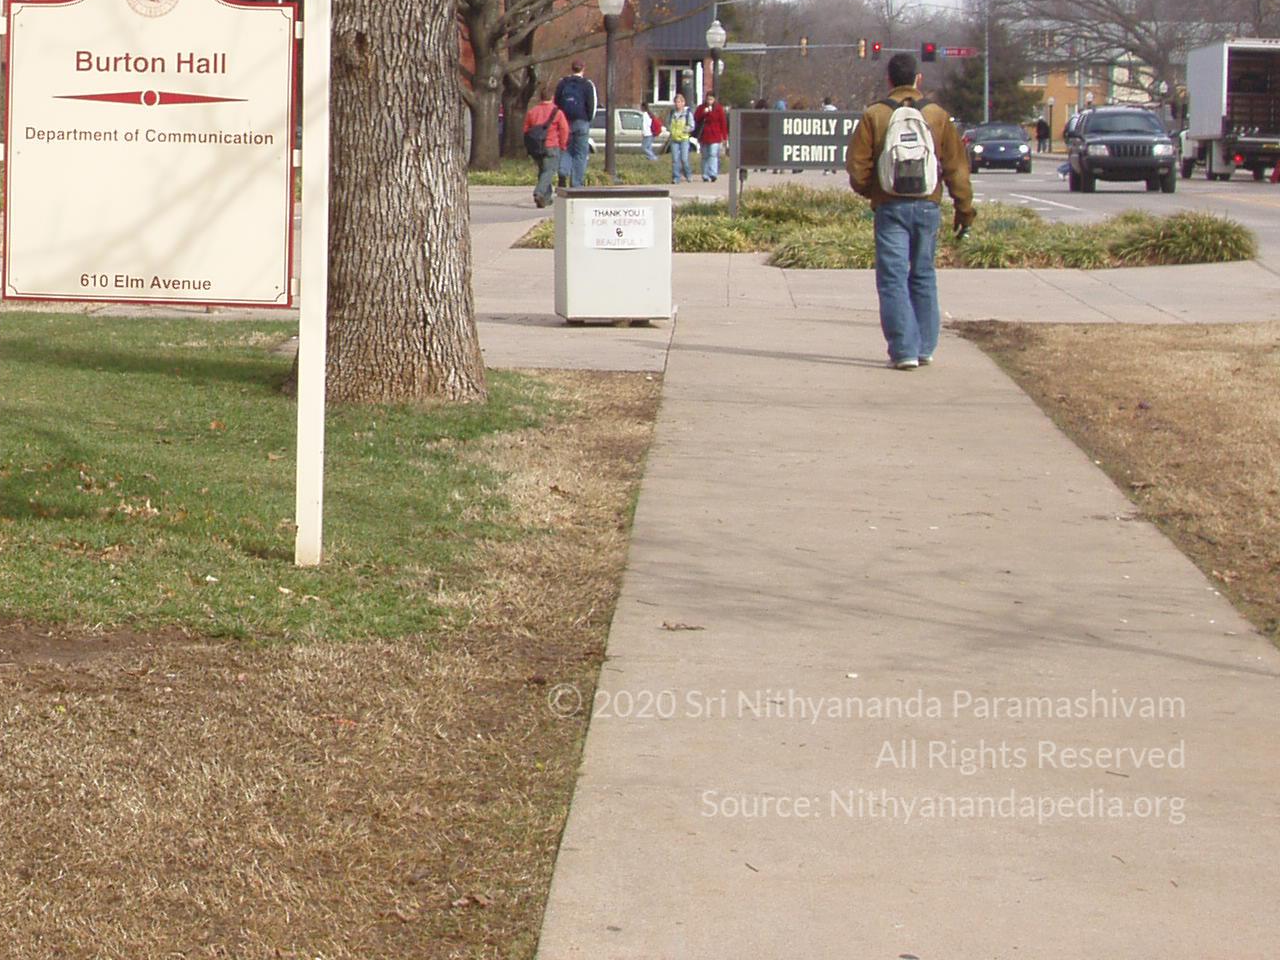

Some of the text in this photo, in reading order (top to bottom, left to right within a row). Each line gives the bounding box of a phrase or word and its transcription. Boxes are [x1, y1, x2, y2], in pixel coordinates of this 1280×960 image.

[76, 51, 226, 74] Burton Hall
[25, 127, 274, 145] Department of Communication
[783, 118, 838, 136] HOURLY
[783, 144, 838, 162] PERMIT
[80, 273, 212, 290] 610 Elm Avenue
